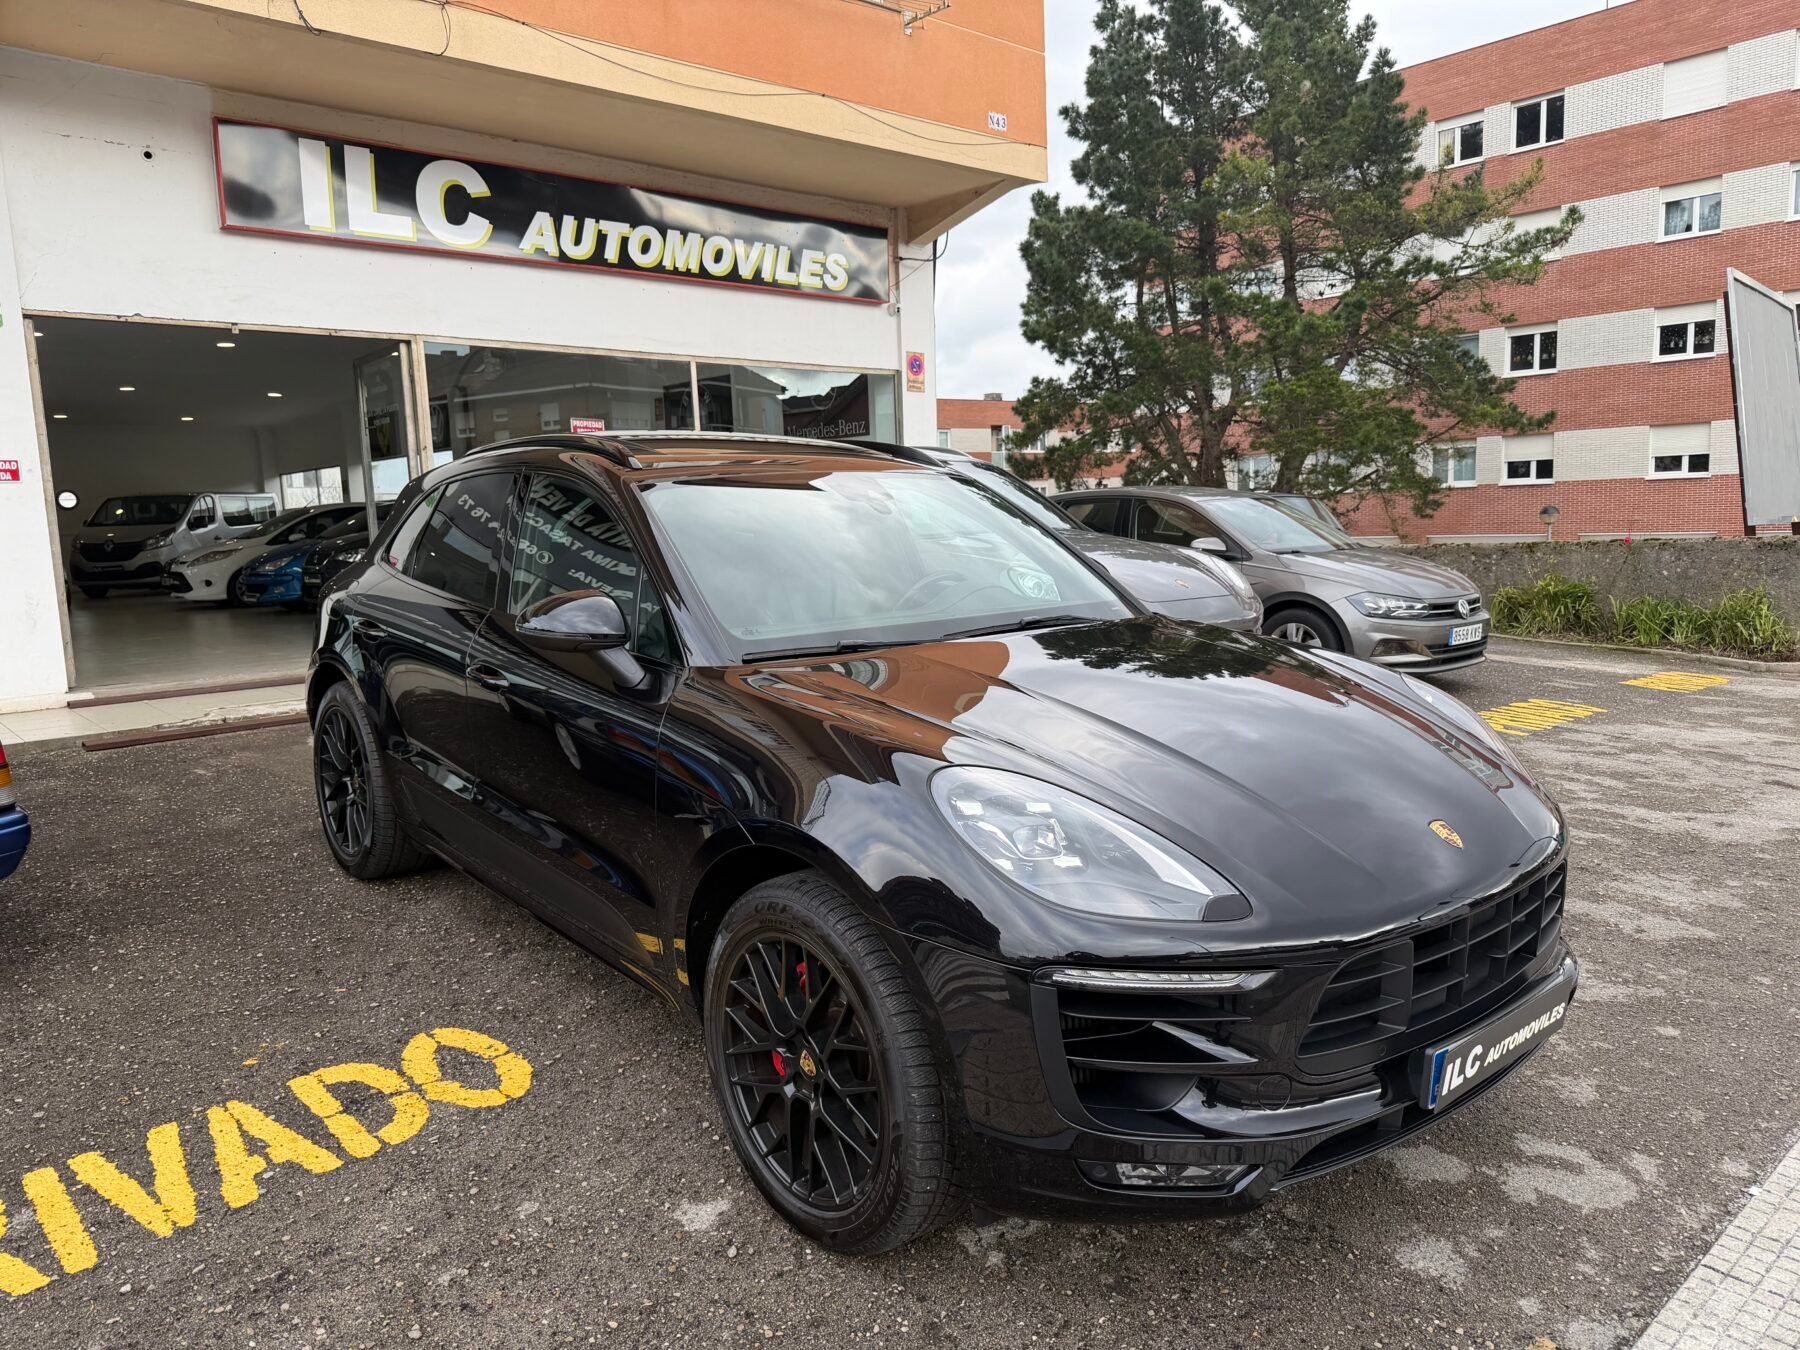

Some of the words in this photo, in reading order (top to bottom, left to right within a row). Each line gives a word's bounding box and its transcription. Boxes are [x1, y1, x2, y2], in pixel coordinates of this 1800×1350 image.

[989, 113, 1006, 129] N43
[298, 137, 493, 249] ILC
[518, 211, 849, 291] AUTOMOVILES
[787, 419, 866, 438] Mercedes-Benz
[1442, 1045, 1483, 1096] ILC
[1484, 1002, 1565, 1067] AUTOMOVILES
